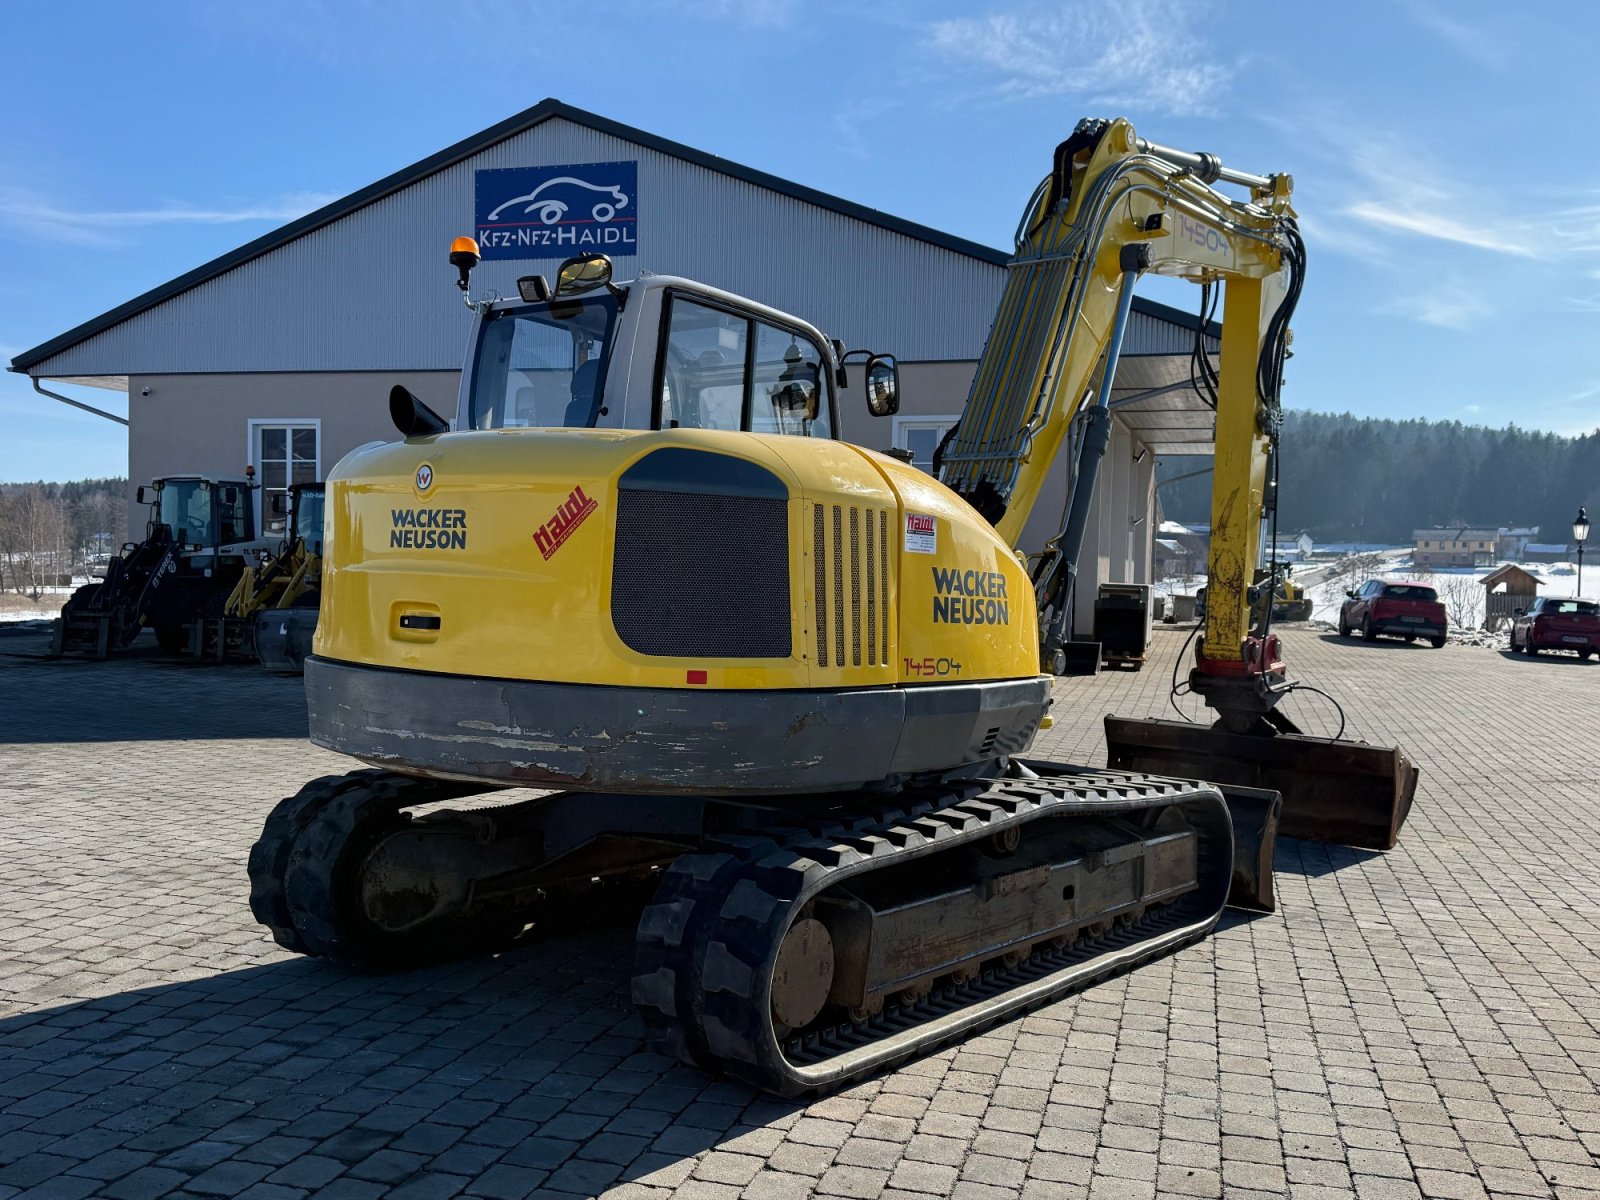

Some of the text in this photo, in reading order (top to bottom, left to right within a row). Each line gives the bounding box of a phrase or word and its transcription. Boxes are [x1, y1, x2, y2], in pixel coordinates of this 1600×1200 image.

[1179, 214, 1229, 257] 14504
[391, 509, 467, 529] WACKER
[390, 530, 466, 550] NEUSON
[156, 551, 174, 578] TEREX
[931, 566, 1008, 599] WACKER
[933, 596, 1009, 626] NEUSON
[904, 657, 962, 677] 14504
